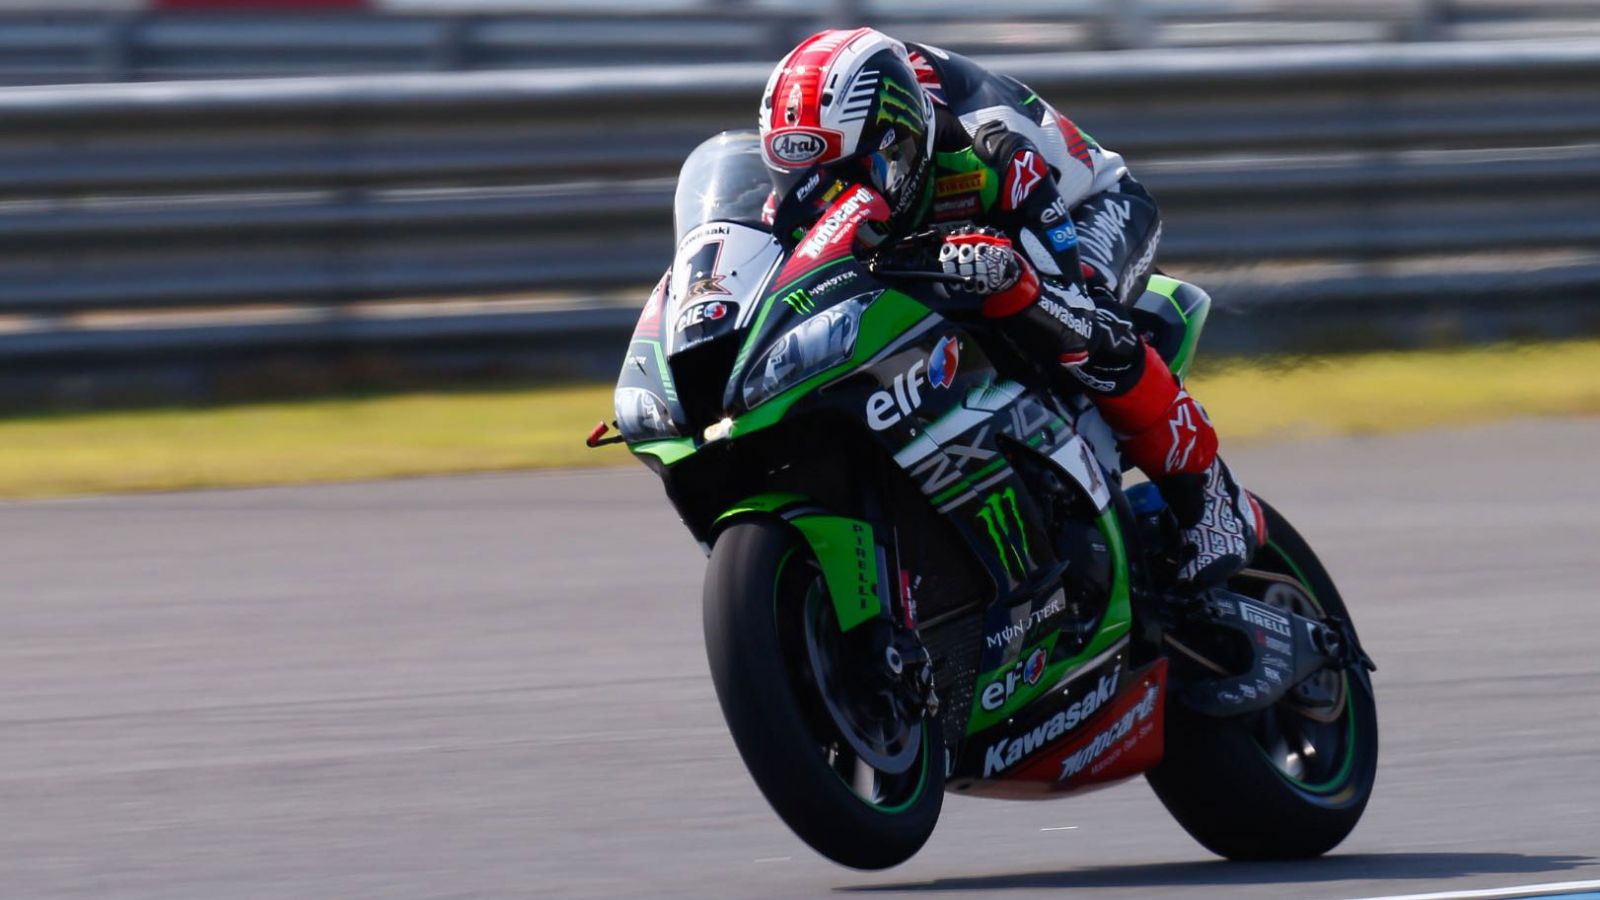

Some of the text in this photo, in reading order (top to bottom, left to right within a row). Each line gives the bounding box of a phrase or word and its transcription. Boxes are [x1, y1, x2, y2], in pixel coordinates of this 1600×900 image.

[779, 136, 816, 153] Arai
[1041, 196, 1068, 223] elf
[1038, 295, 1092, 339] awasaki
[866, 359, 924, 431] elf
[1239, 601, 1291, 637] PIRELLI
[983, 663, 1122, 779] Kawasaki
